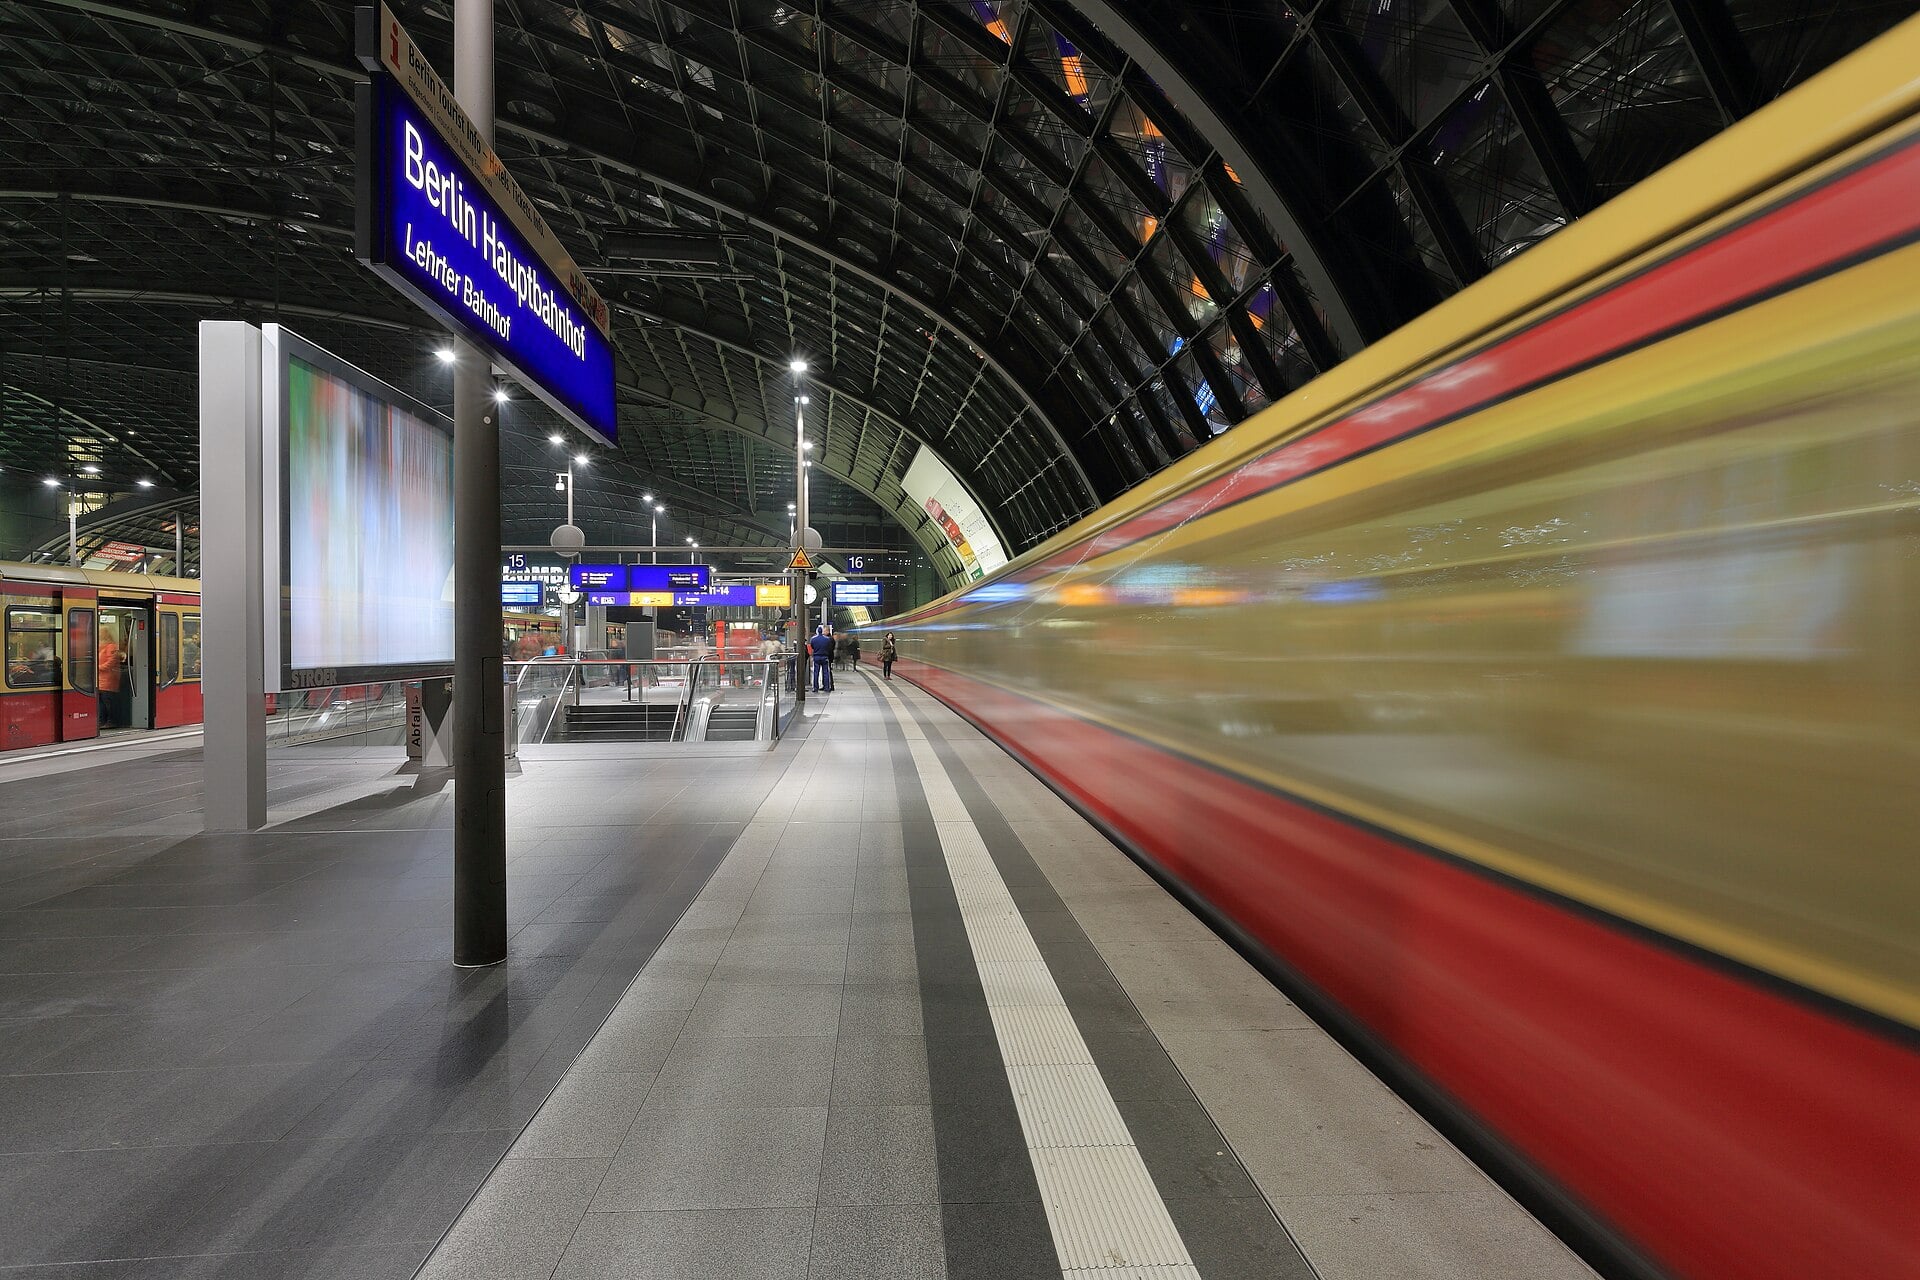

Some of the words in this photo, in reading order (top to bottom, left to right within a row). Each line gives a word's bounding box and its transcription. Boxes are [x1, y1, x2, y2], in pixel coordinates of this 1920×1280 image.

[408, 42, 436, 96] Berlin
[438, 81, 465, 134] Tourist
[467, 121, 481, 154] Info
[489, 150, 511, 194] Hotels.
[405, 119, 477, 249] Berlin
[483, 209, 586, 361] Hauptbahnhof
[405, 222, 462, 297] Lehrter
[463, 274, 511, 342] Bahnhof
[508, 554, 524, 568] 15
[848, 556, 864, 569] 16
[411, 705, 420, 748] Abfall
